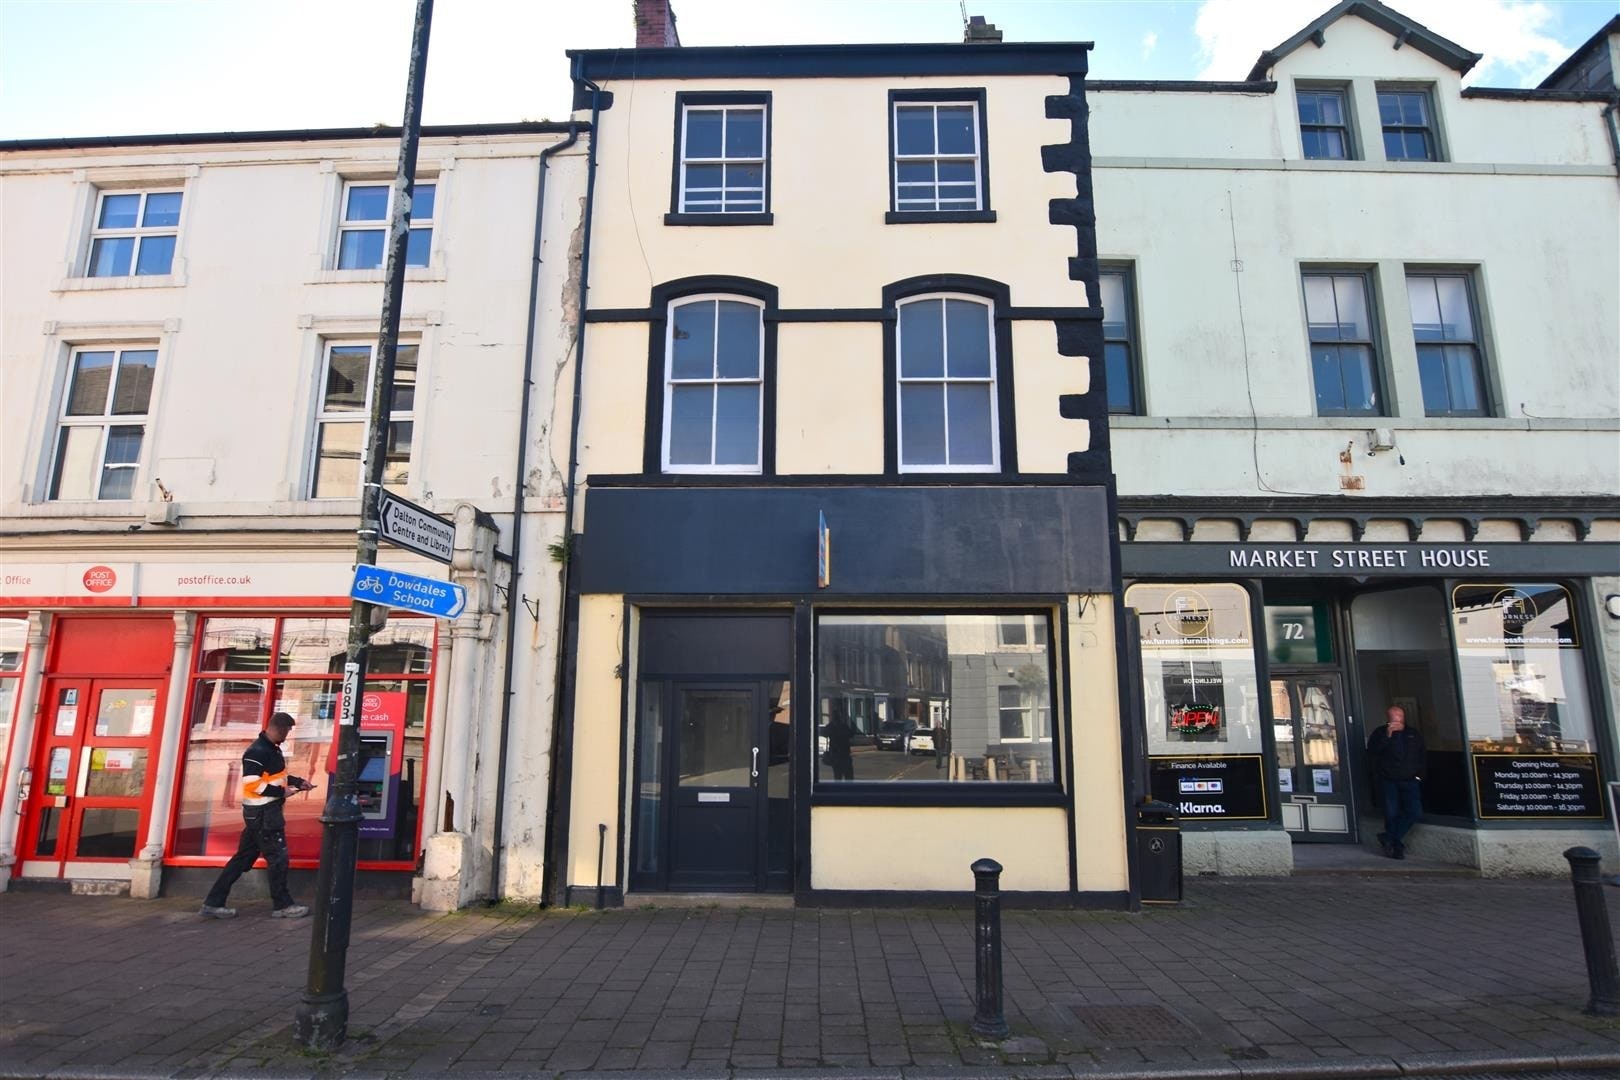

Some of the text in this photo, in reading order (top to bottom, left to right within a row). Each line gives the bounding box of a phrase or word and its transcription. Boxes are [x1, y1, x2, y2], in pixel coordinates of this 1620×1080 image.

[393, 507, 453, 543] Dalton Community
[392, 521, 450, 556] Centre and Library
[1229, 549, 1490, 568] MARKET STREET HOUSE
[5, 575, 32, 585] Office
[90, 571, 111, 579] POST
[177, 575, 252, 586] postoffice.co.uk
[388, 576, 447, 598] Dowdales
[393, 591, 435, 609] School
[1282, 622, 1305, 640] 72
[341, 670, 354, 720] 7683
[370, 712, 389, 721] cash
[1171, 709, 1219, 728] OPEN
[1197, 761, 1227, 769] Available
[1512, 760, 1540, 769] Opening
[1494, 771, 1520, 779] Monday
[1494, 782, 1523, 790] Thursday
[1500, 792, 1520, 800] Friday
[1180, 801, 1226, 814] Klarna.
[1496, 803, 1526, 811] Saturday
